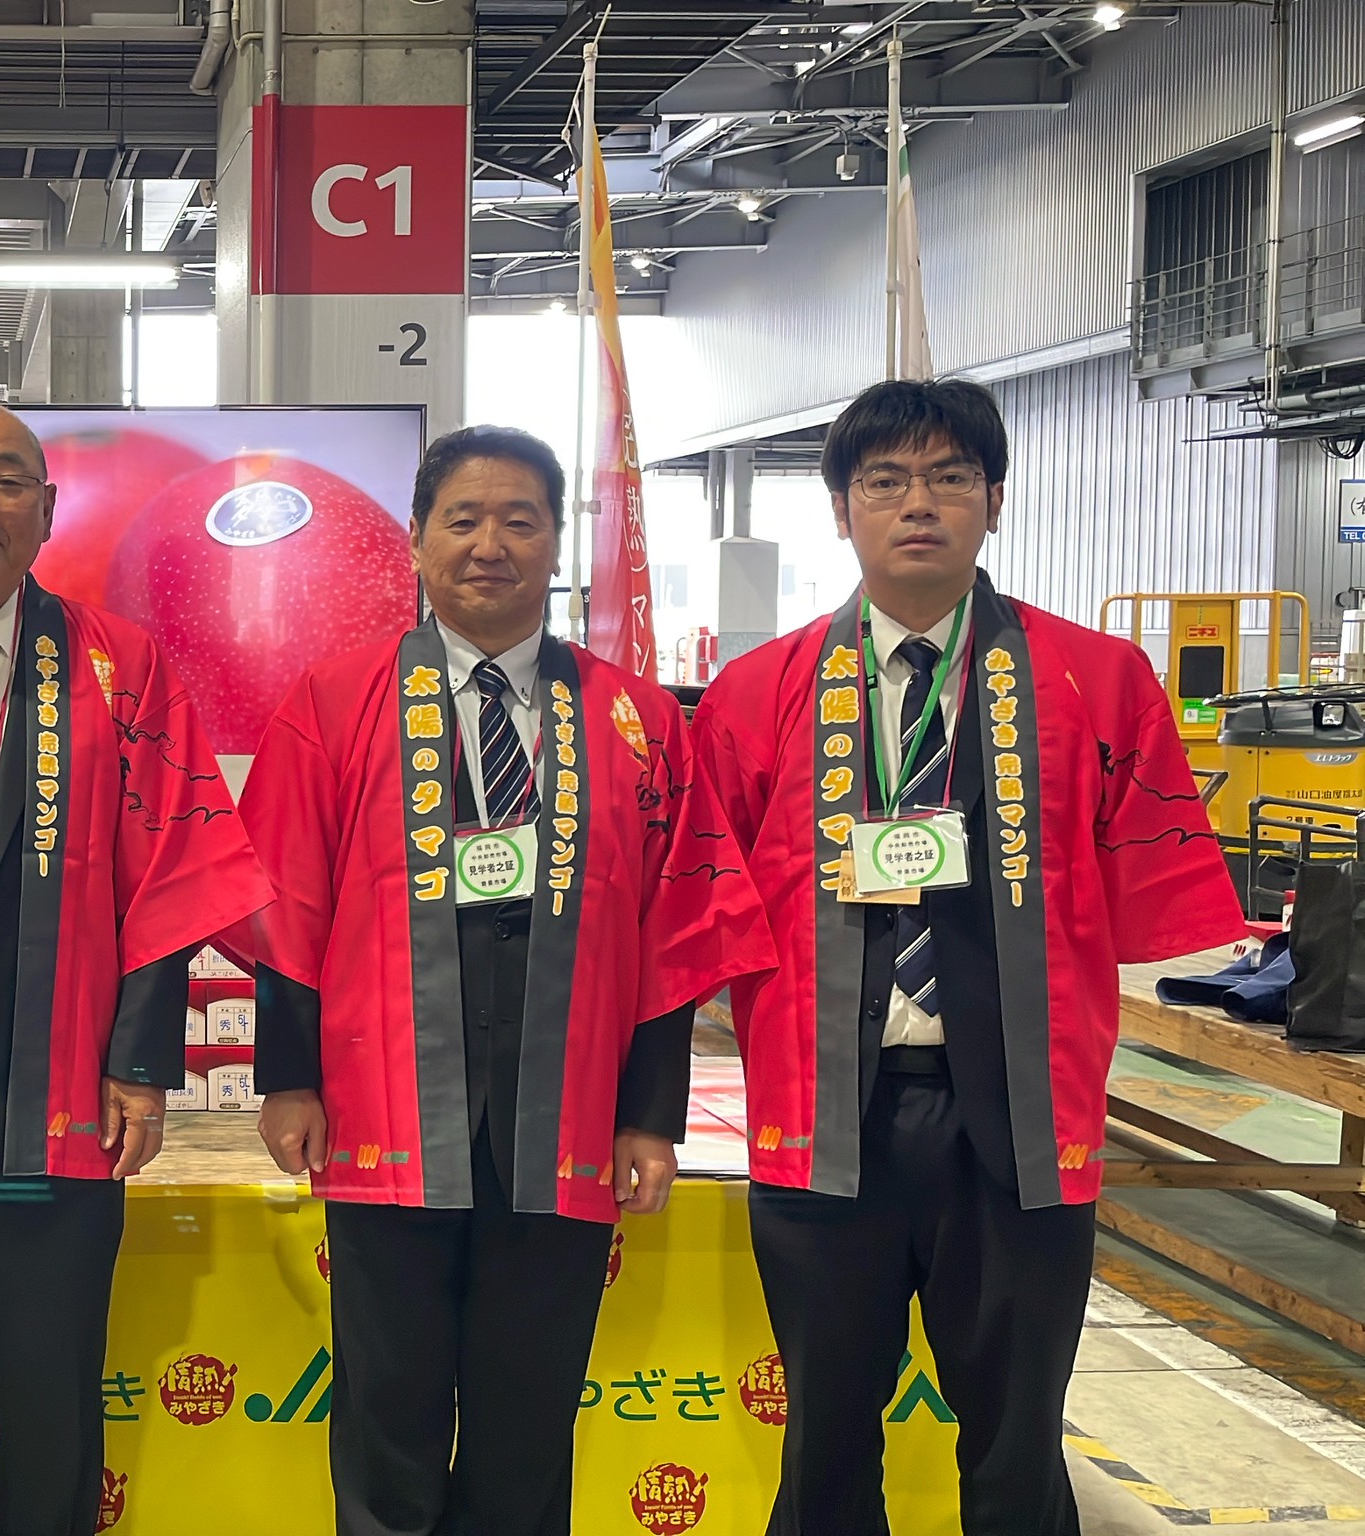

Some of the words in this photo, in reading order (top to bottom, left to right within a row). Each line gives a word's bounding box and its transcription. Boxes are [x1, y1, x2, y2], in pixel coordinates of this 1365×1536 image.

[311, 163, 412, 237] C1
[378, 322, 428, 366] -2
[1344, 532, 1360, 540] TEL
[403, 665, 449, 902] 太陽のタマゴ
[885, 849, 935, 864] 見学者之証
[469, 860, 515, 876] 見学者之証
[220, 1019, 231, 1031] 秀
[222, 1085, 233, 1097] 秀
[170, 1401, 225, 1415] みやざき
[641, 1511, 696, 1526] みやざき
